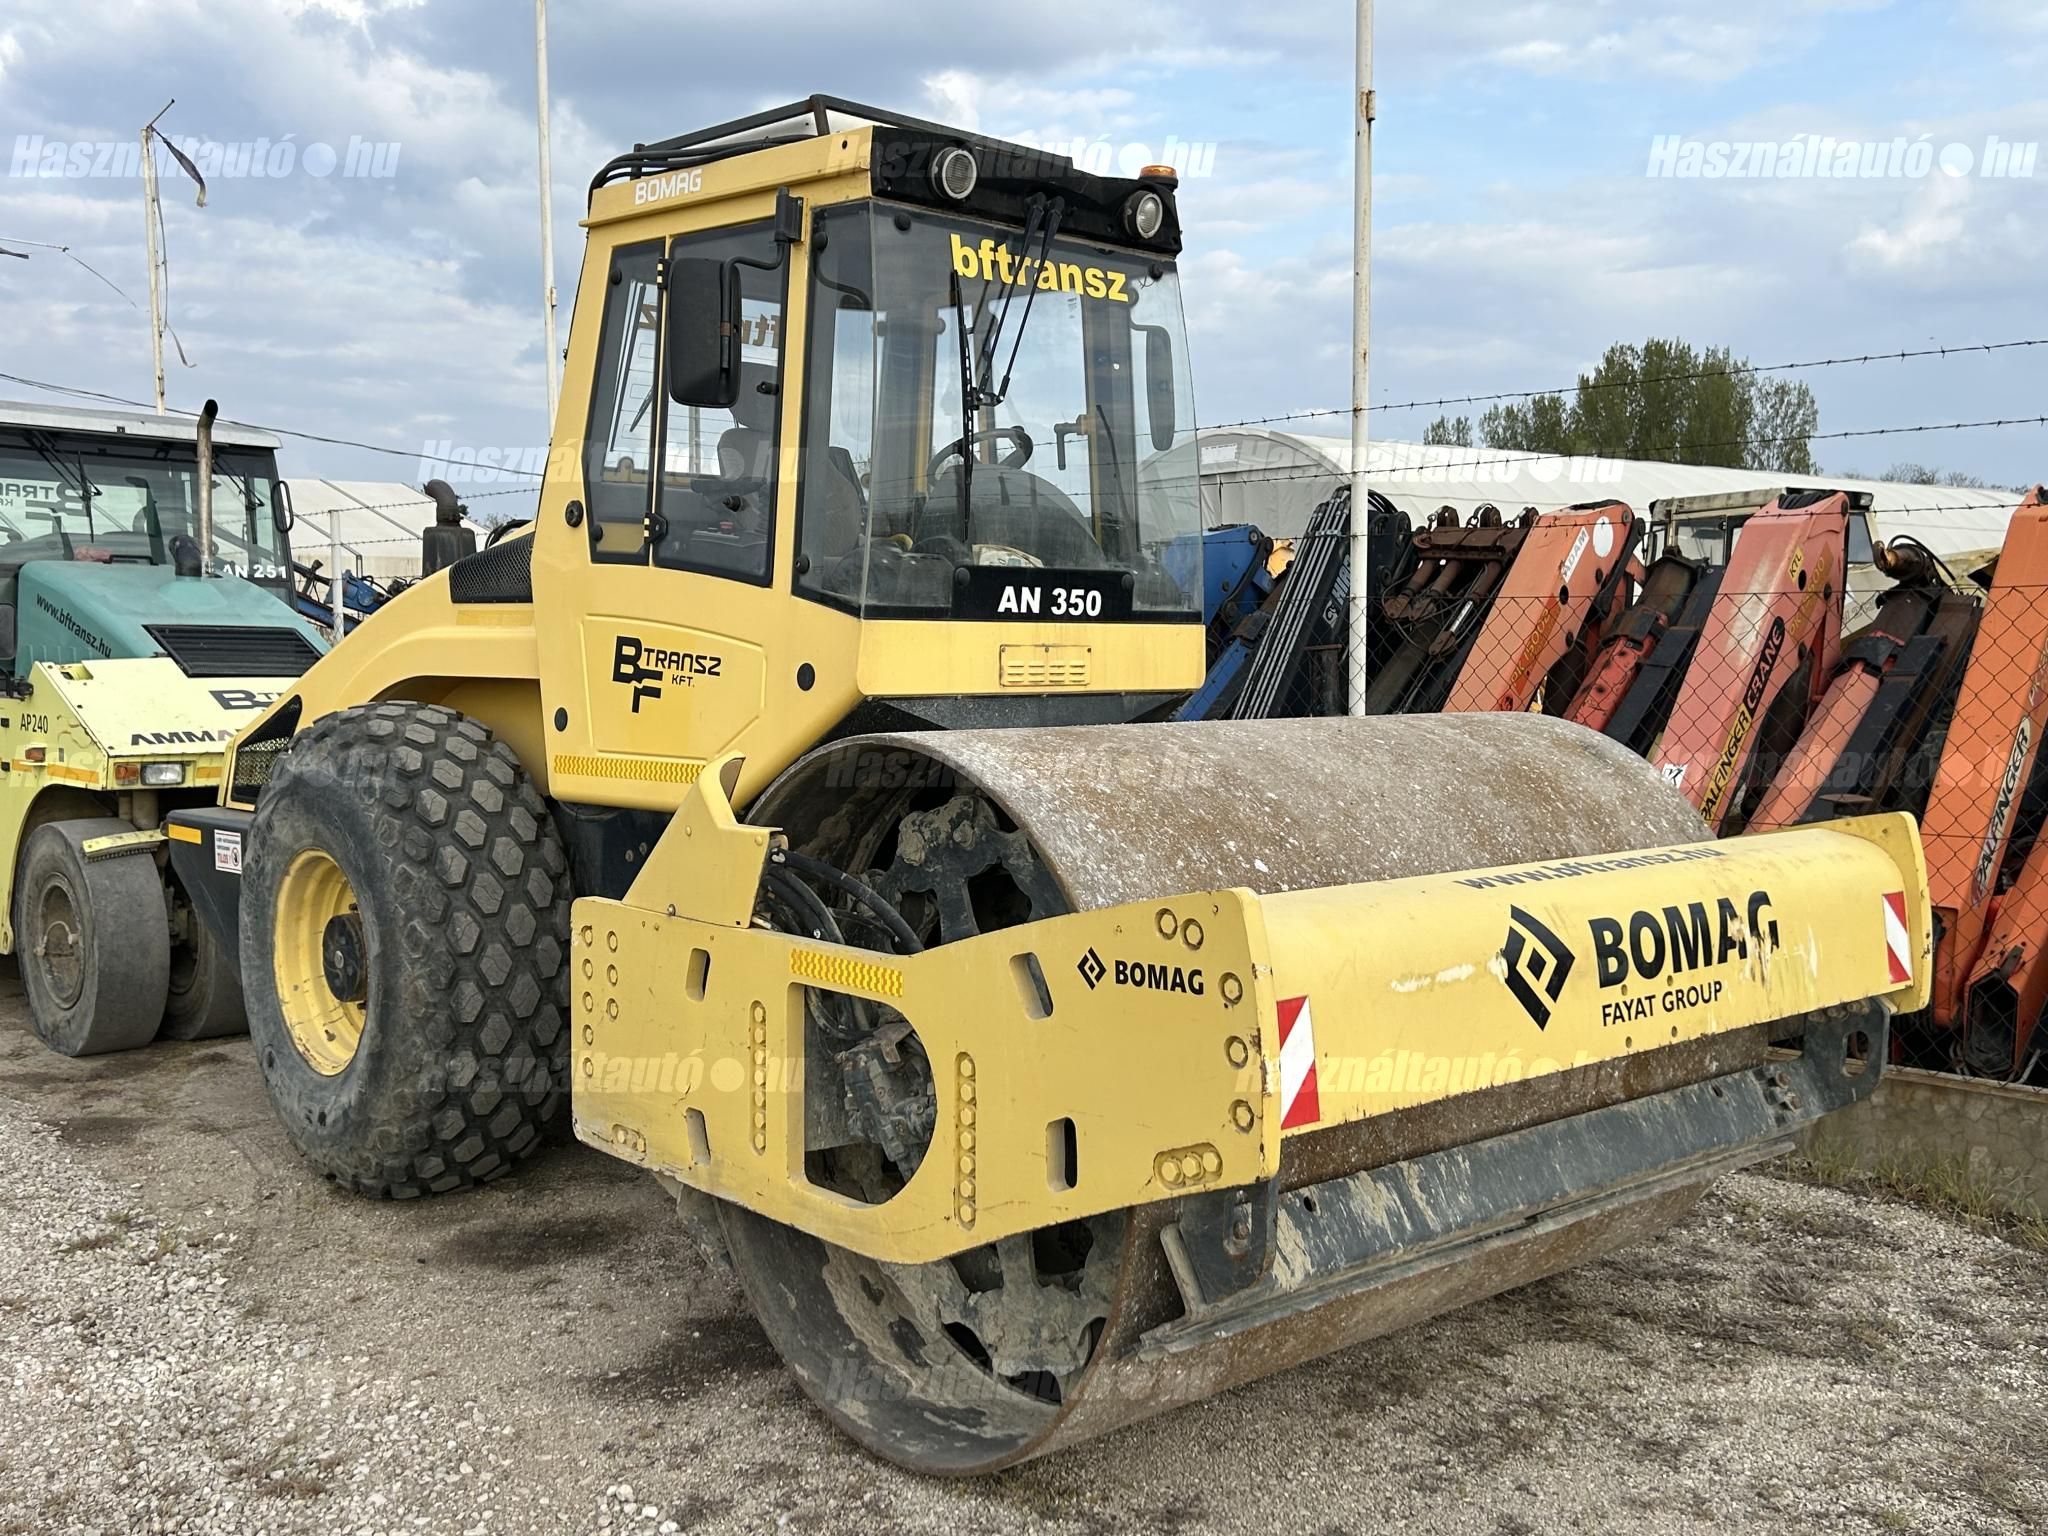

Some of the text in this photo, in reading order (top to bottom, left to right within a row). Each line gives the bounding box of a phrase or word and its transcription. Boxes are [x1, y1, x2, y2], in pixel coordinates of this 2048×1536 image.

[634, 168, 704, 206] BOMAG
[950, 233, 1129, 302] bftransz
[253, 563, 287, 579] 251
[997, 585, 1102, 617] AN 350
[36, 593, 112, 659] www.bftransz.hu
[643, 646, 722, 677] TRANSZ
[20, 712, 48, 735] AP240
[1700, 625, 1784, 820] PALFINGER CRANE
[1453, 847, 1727, 890] www.bftransz.hu
[1588, 890, 1781, 989] BOMAG
[1115, 960, 1204, 996] BOMAG
[1601, 980, 1723, 1027] FAYAT GROUP
